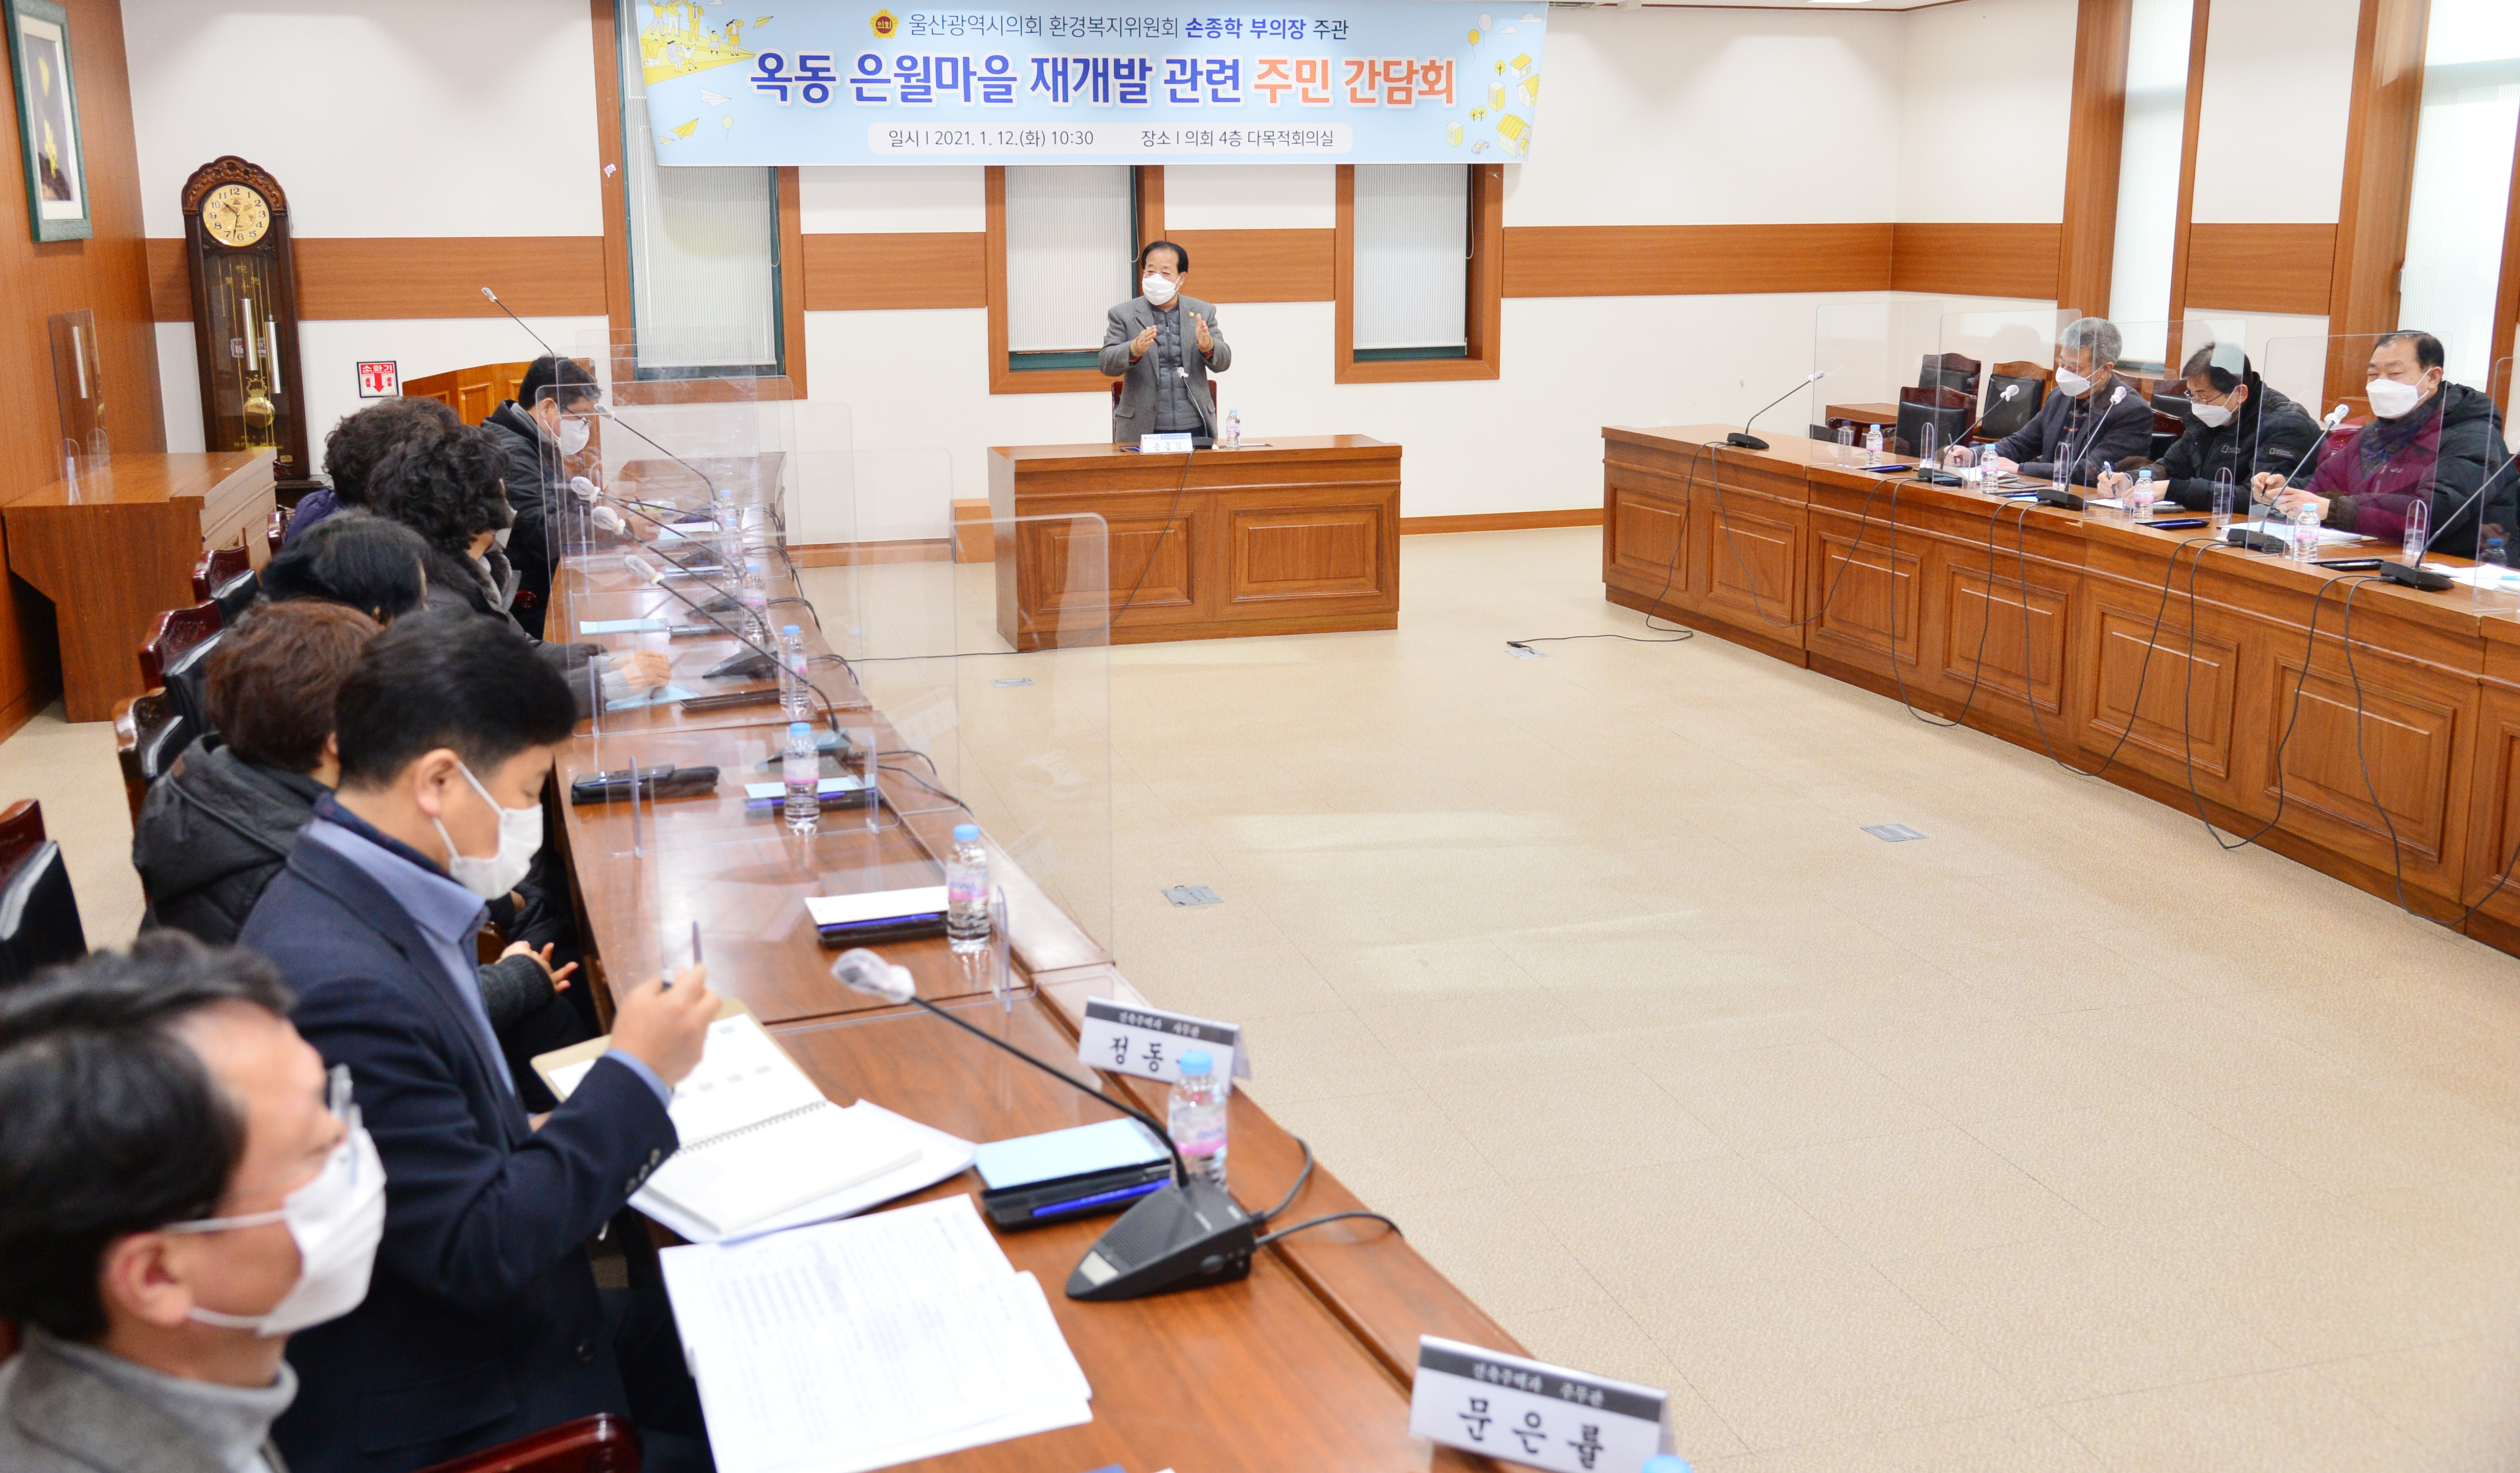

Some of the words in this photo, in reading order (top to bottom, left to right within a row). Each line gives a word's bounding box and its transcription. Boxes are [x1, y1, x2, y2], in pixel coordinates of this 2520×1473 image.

[877, 20, 891, 29] 의회
[909, 14, 1042, 37] 울산광역시의회
[1049, 15, 1178, 38] 환경복지위원회
[1185, 17, 1243, 39] 손종학
[1250, 18, 1307, 39] 부의장
[1313, 19, 1349, 40] 주관
[750, 52, 837, 104] 옥동
[849, 54, 1018, 103] 은월마을
[1030, 57, 1153, 104] 재개발
[1163, 58, 1241, 103] 관련
[1254, 59, 1330, 104] 주민
[1344, 59, 1453, 105] 간담회
[889, 130, 919, 147] 일시
[934, 131, 974, 146] 2021.
[980, 131, 992, 146] 1.
[997, 130, 1045, 147] 12.(화)
[1051, 130, 1094, 145] 10:30
[1141, 130, 1171, 147] 장소
[1185, 130, 1213, 147] 의회
[1219, 130, 1243, 147] 4층
[1248, 130, 1334, 147] 다목적회의실
